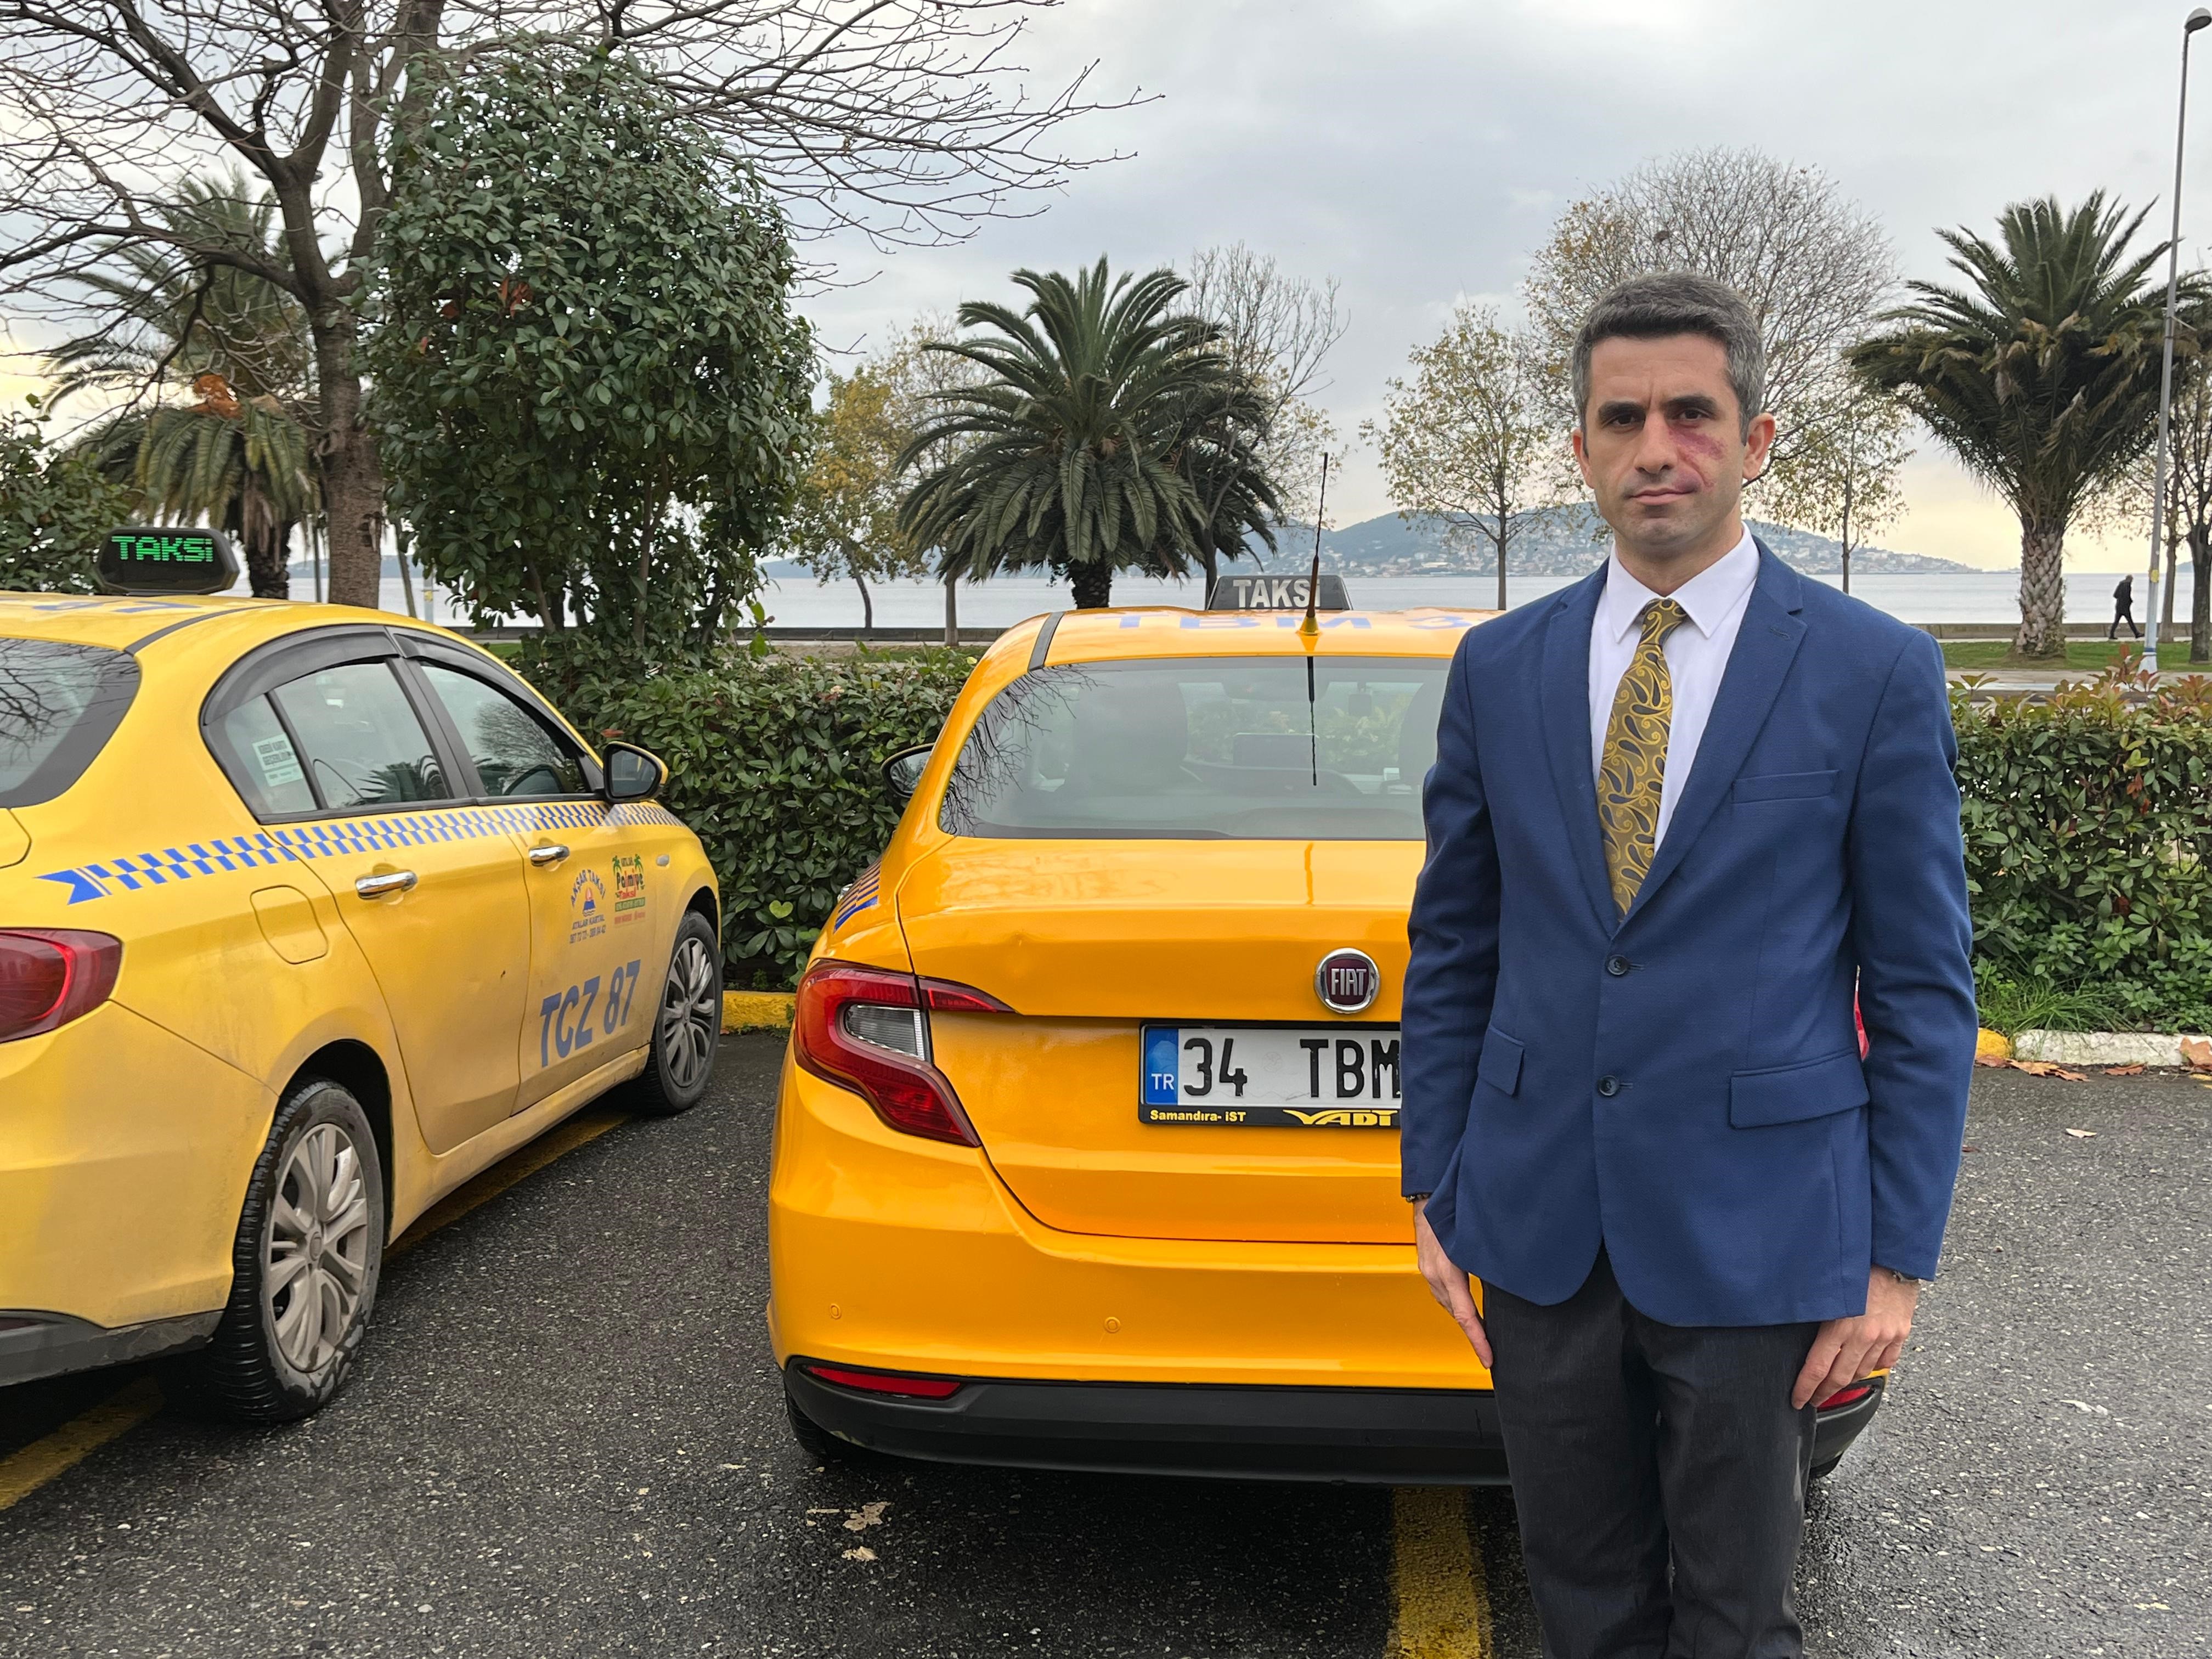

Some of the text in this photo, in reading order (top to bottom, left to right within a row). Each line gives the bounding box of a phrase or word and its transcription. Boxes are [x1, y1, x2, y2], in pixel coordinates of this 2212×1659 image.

[1406, 615, 1488, 630] 3
[1331, 968, 1367, 996] FIAT
[540, 959, 641, 1068] TCZ 87
[1184, 1037, 1401, 1098] 34 TBM
[1151, 1073, 1175, 1091] TR
